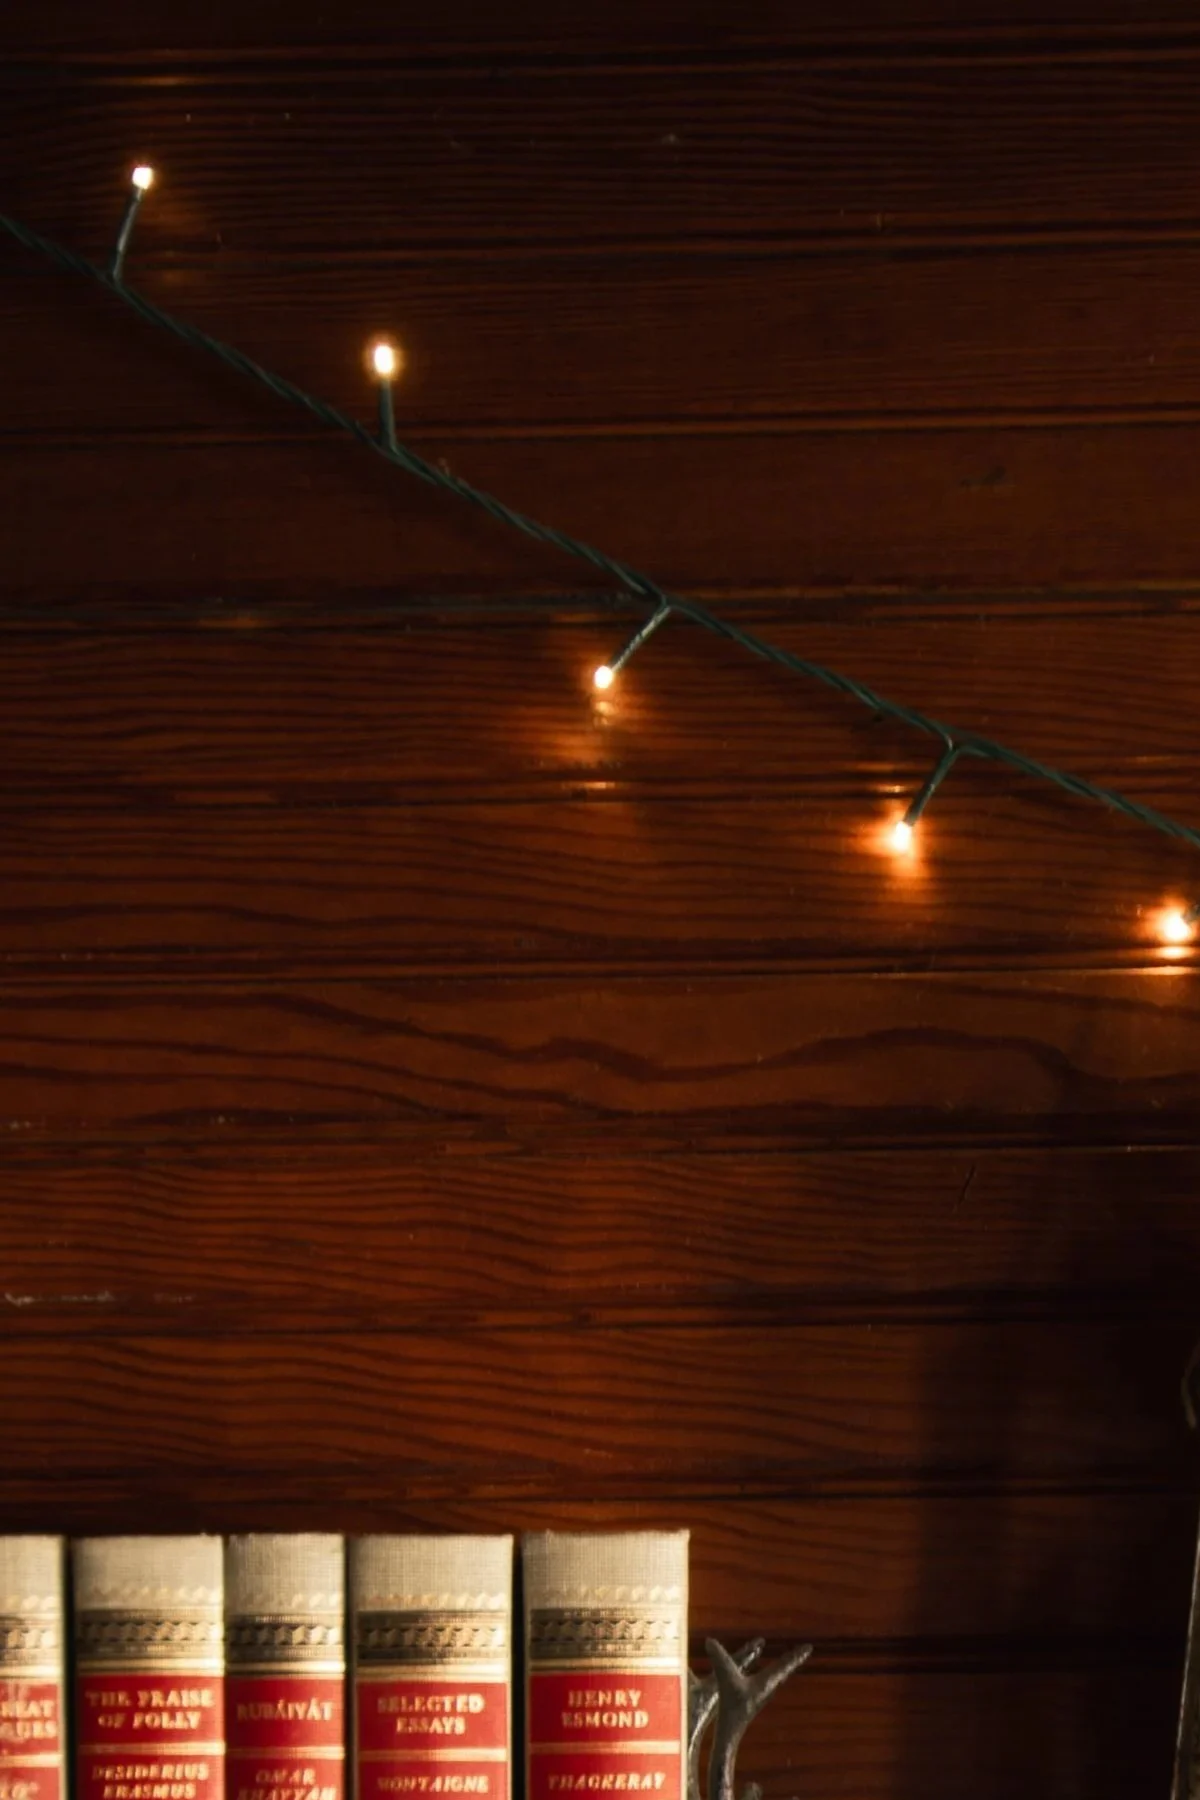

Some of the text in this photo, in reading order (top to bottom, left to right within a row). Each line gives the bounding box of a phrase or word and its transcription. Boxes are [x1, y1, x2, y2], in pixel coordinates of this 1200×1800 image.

[86, 1689, 214, 1708] THE PRAISE
[377, 1693, 485, 1714] SELECTED
[568, 1689, 642, 1708] HENRY
[98, 1711, 201, 1730] OF FOLLY
[396, 1716, 466, 1735] ESSAYS
[562, 1711, 649, 1729] ESMOND
[93, 1763, 209, 1781] DESIDERIUS
[255, 1767, 317, 1786] OMAR
[548, 1771, 666, 1790] THACKERAY
[104, 1782, 197, 1800] ERASMUS
[377, 1775, 489, 1793] MONTAIGNE
